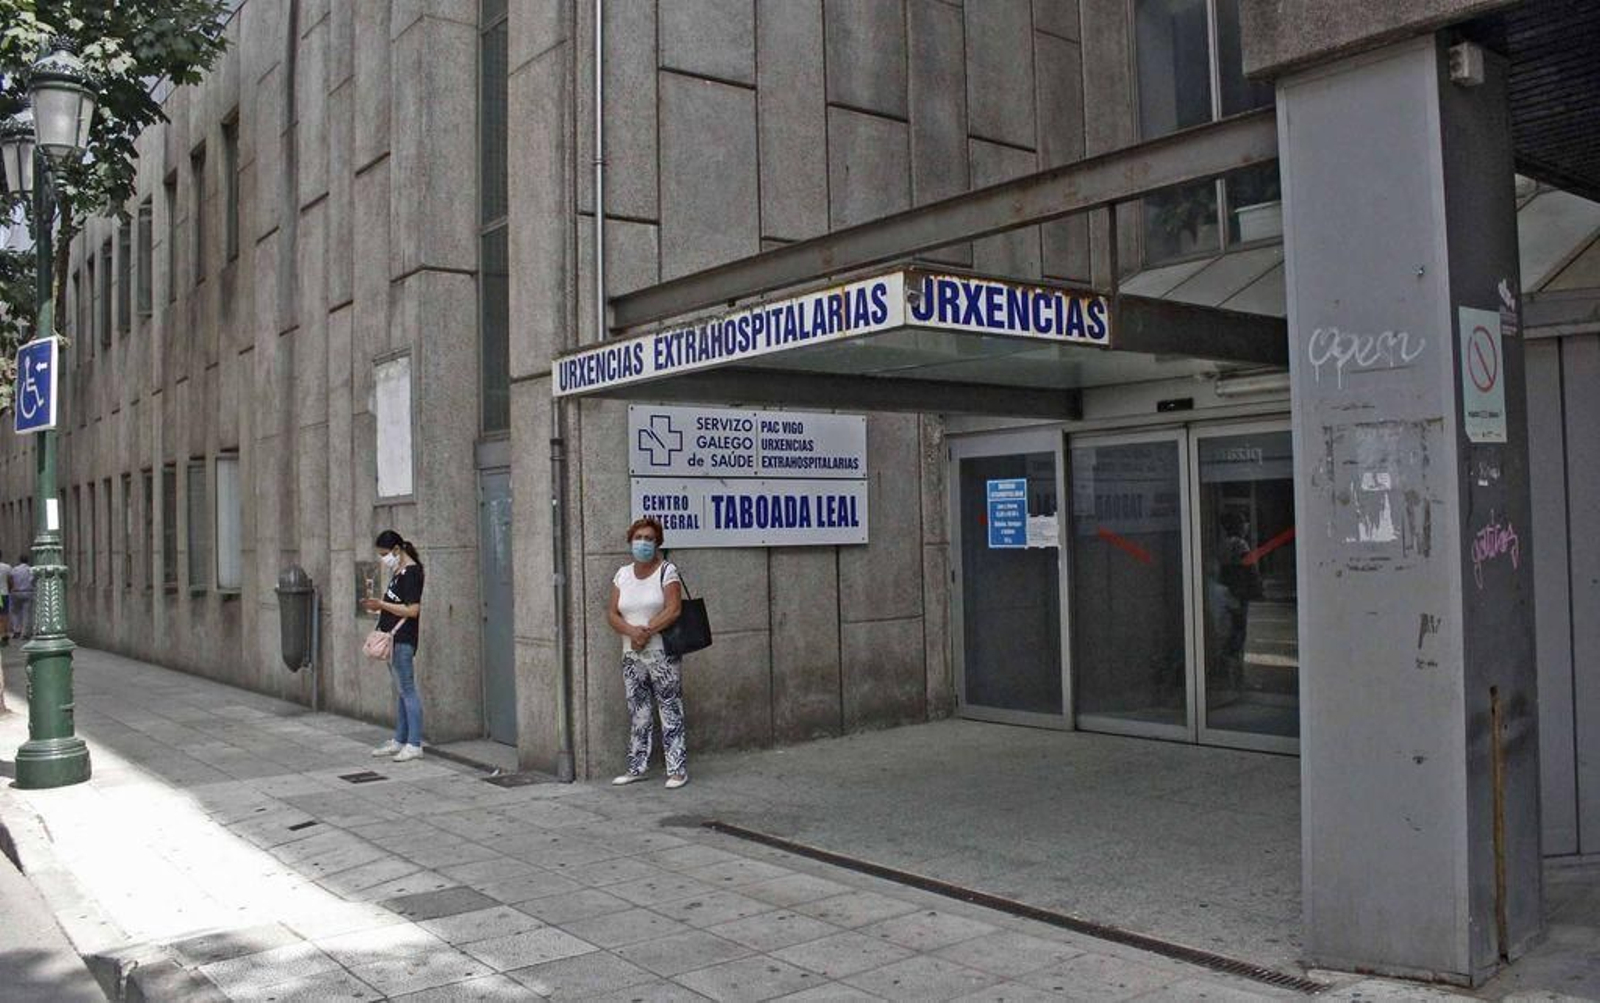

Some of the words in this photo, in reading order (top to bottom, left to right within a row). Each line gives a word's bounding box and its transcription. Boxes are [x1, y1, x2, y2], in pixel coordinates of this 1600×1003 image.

[911, 275, 1106, 340] URXENCIAS
[559, 342, 644, 391] URXENCIAS
[654, 283, 888, 371] EXTRAHOSPITALARIAS
[696, 417, 754, 432] SERVIZO
[761, 421, 780, 434] PAC
[782, 421, 804, 434] VIGO
[696, 436, 754, 450] GALEGO
[761, 438, 814, 451] URXENCIAS
[687, 452, 704, 467] de
[711, 451, 754, 468] SAÚDE
[761, 455, 859, 469] EXTRAHOSPITALARIAS
[642, 494, 689, 511] CENTRO
[711, 494, 812, 530] TABOADA
[817, 494, 859, 528] LEAL
[643, 513, 700, 530] TEGRAL
